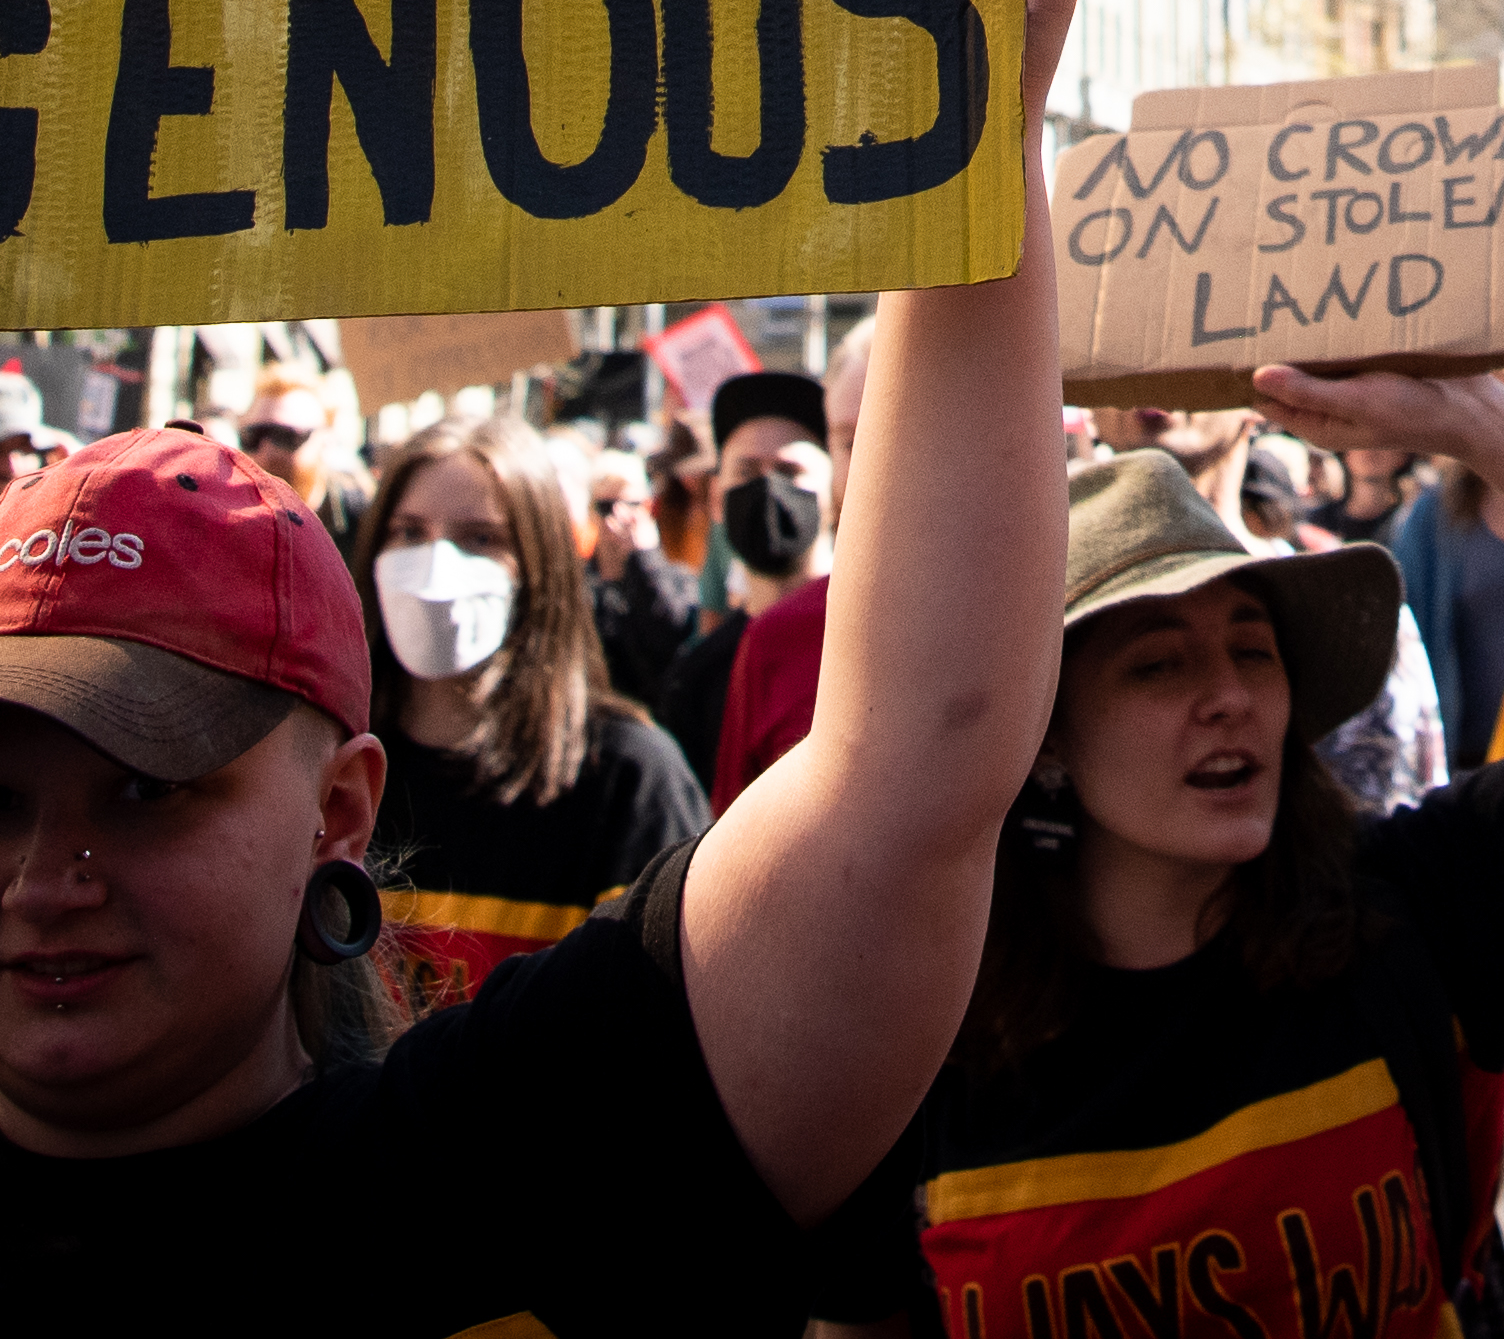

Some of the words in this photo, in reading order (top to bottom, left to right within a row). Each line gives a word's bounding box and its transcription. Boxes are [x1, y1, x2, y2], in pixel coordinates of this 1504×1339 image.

[1073, 129, 1230, 200] NO
[1069, 196, 1219, 265] ON
[1192, 254, 1444, 346] LAND
